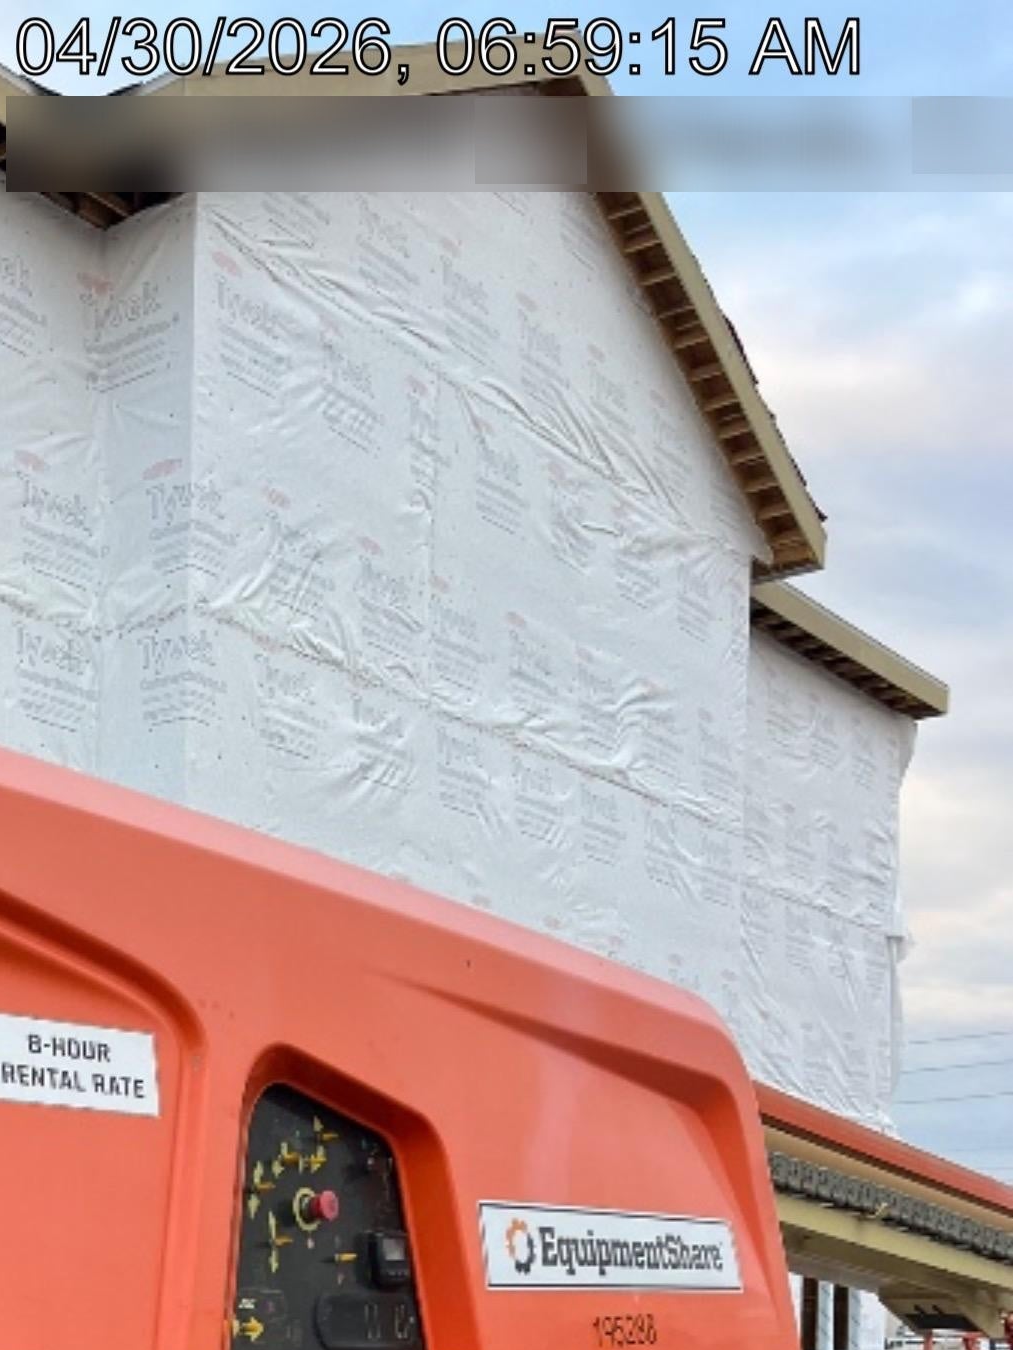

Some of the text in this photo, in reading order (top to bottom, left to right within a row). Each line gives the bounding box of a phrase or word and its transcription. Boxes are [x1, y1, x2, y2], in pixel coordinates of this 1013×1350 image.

[1, 1061, 145, 1099] RENTAL RATE
[538, 1226, 724, 1276] EquipmentShare
